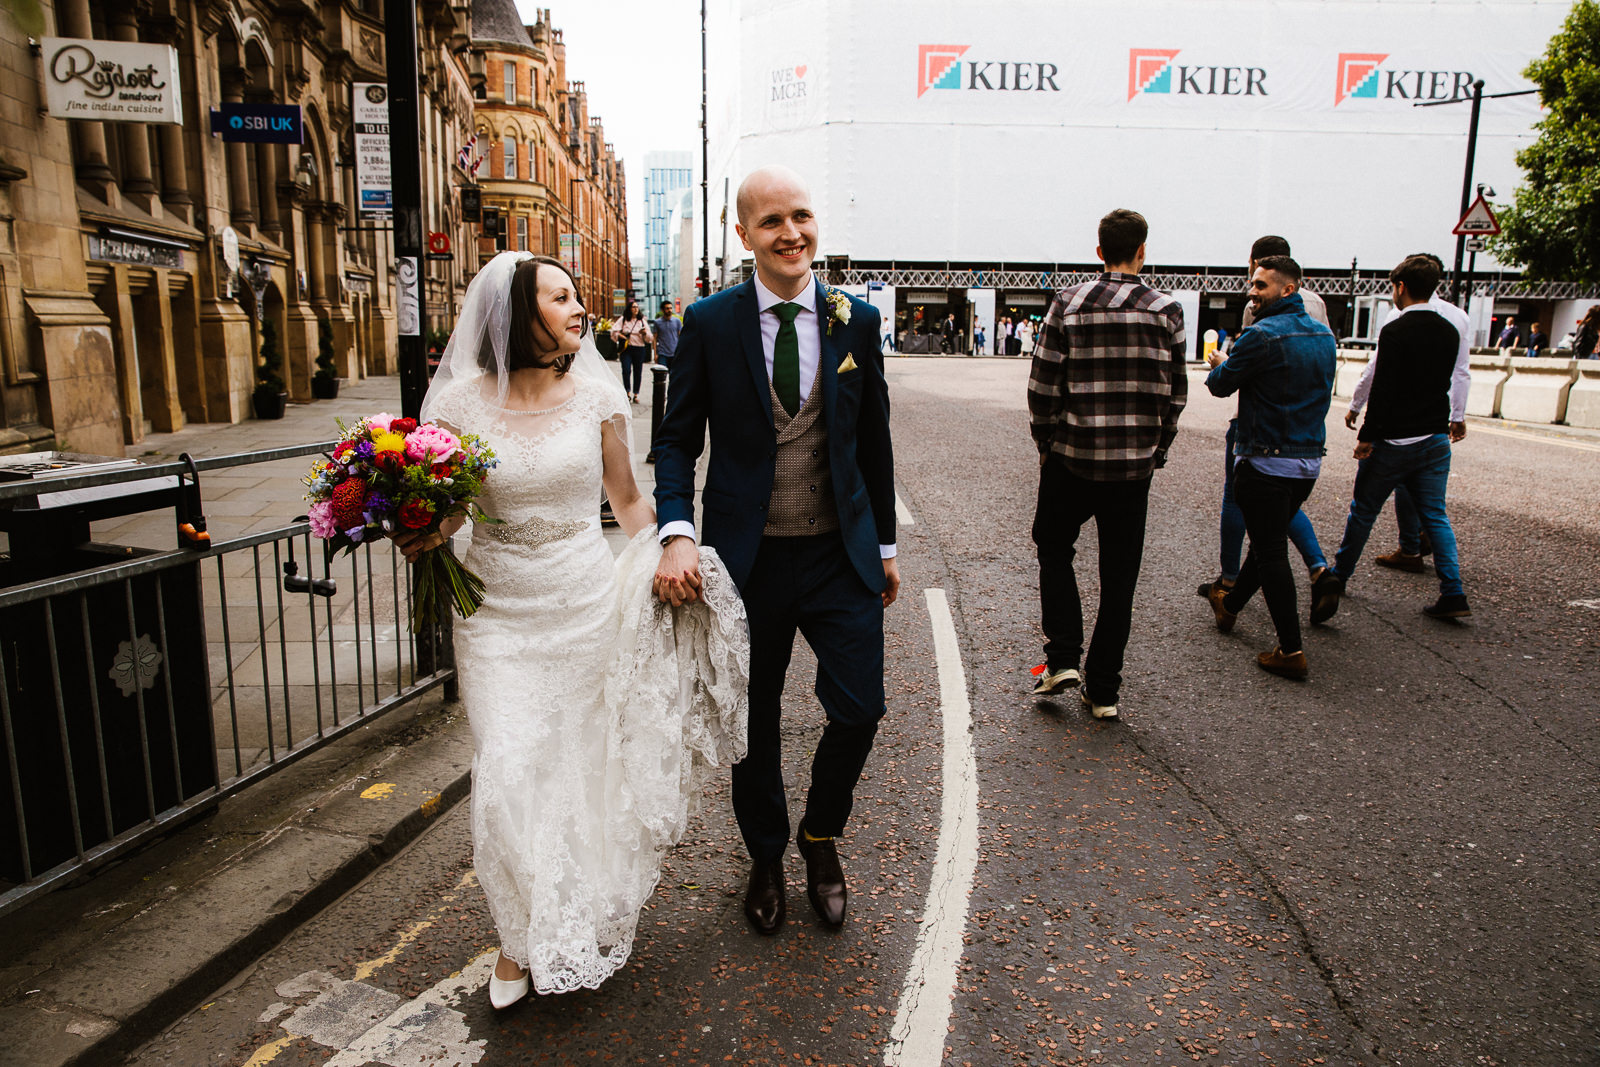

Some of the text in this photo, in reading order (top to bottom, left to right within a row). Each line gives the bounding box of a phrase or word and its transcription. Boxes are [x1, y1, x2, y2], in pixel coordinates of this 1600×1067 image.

[50, 44, 166, 99] Rajdoot
[772, 67, 793, 83] WE
[967, 61, 1061, 92] KIER
[1177, 66, 1269, 96] KIER
[1384, 70, 1474, 100] KIER
[118, 91, 162, 102] tandoori
[771, 81, 807, 101] MCR
[65, 100, 164, 114] fine indian cuisine
[244, 116, 293, 131] SBI UK
[364, 124, 375, 134] TO
